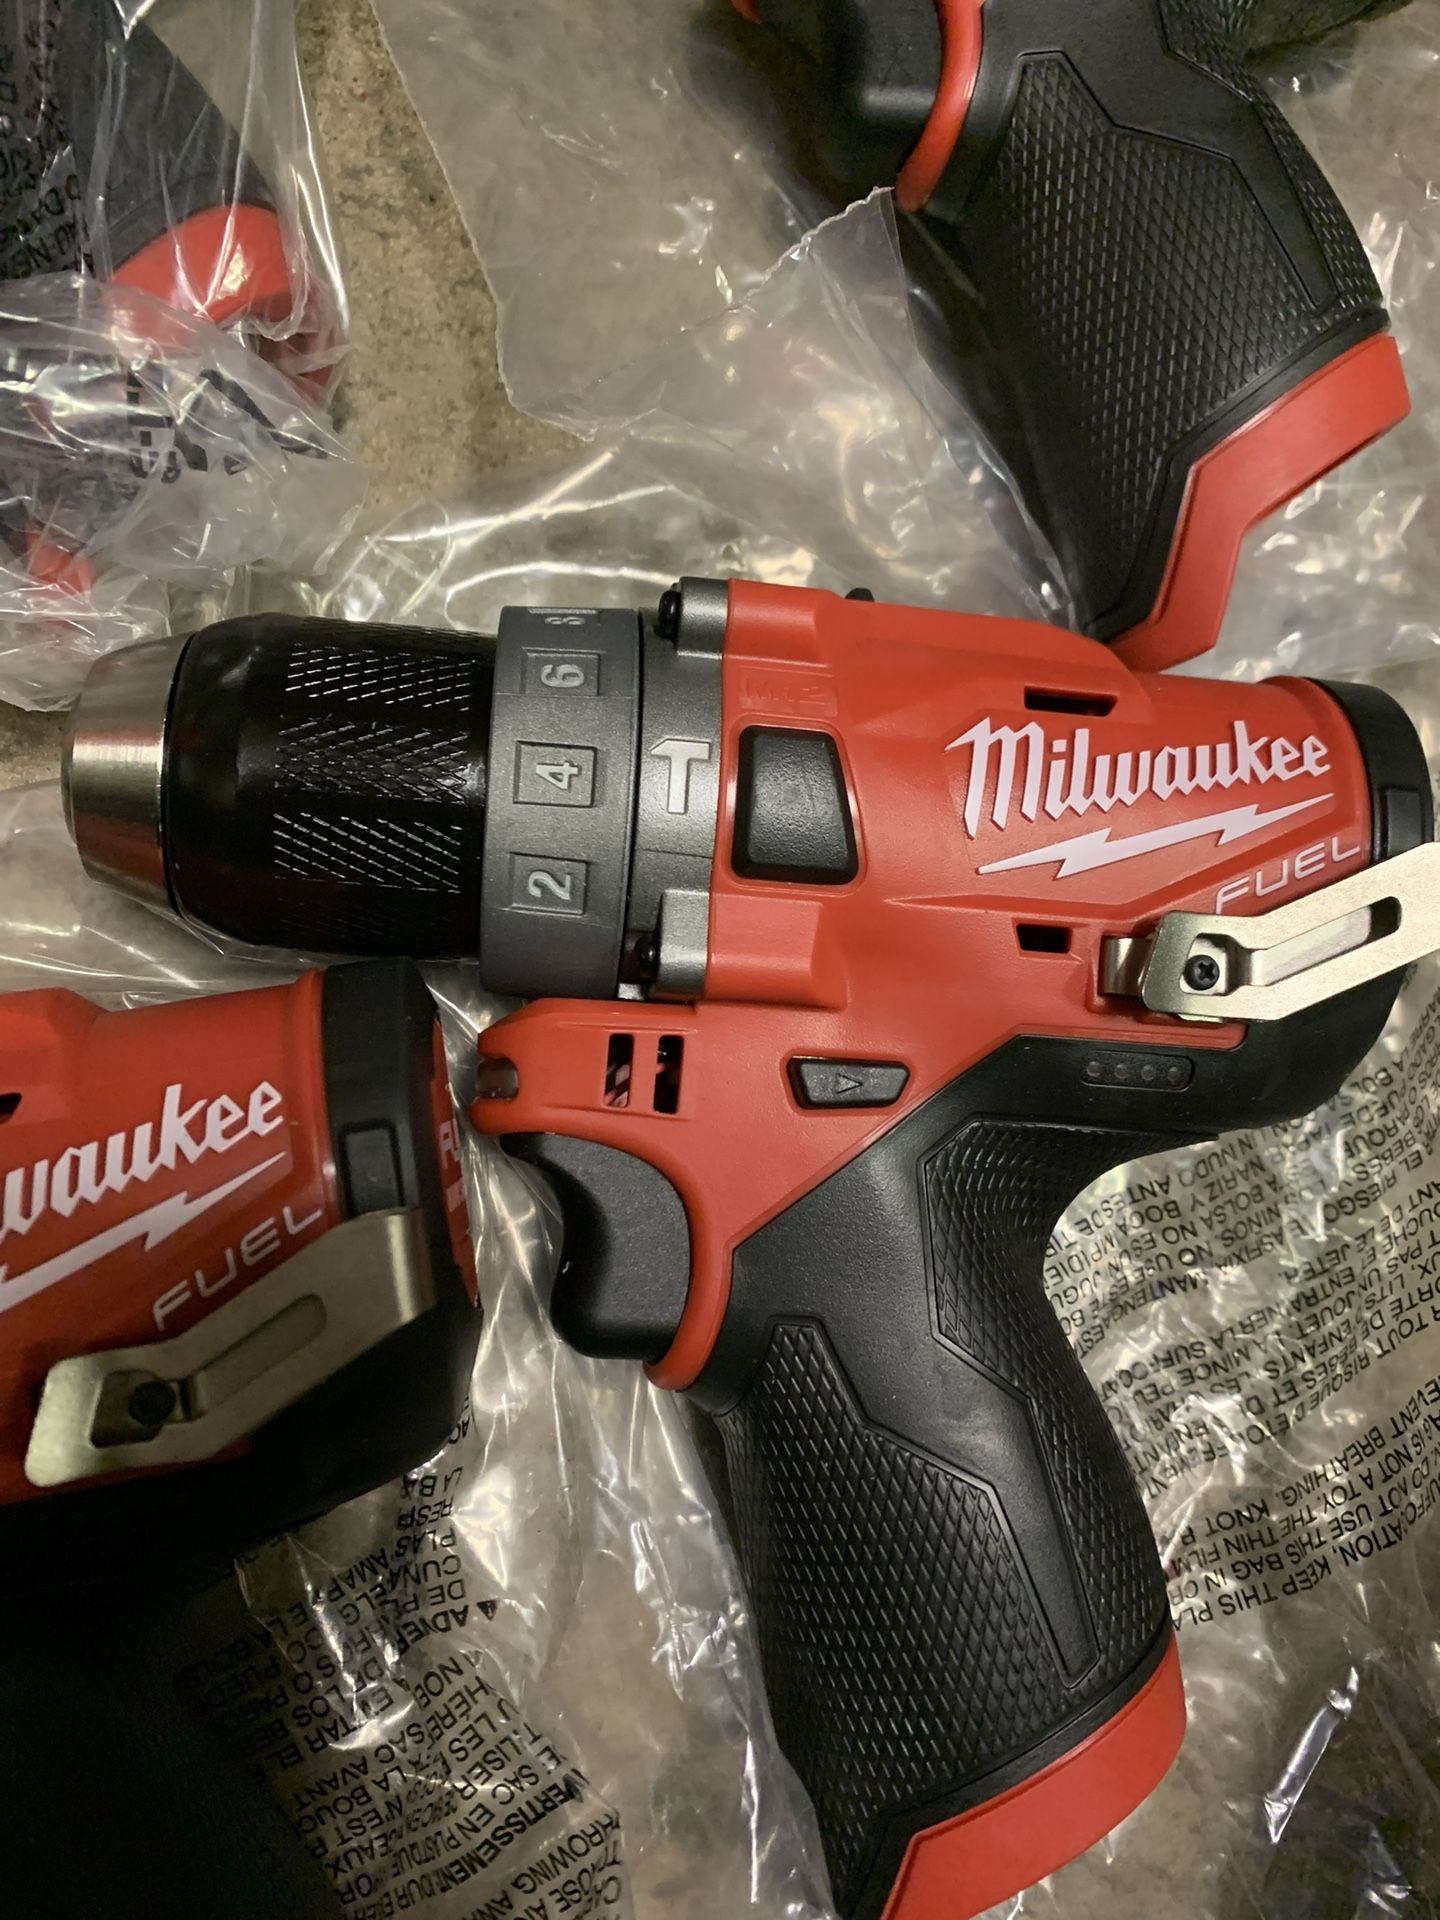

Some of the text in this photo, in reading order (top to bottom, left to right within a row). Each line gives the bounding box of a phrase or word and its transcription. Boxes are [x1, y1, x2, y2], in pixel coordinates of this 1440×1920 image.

[540, 663, 586, 689] 6
[535, 759, 579, 791] 4
[944, 716, 1333, 840] Milwaukee
[528, 869, 572, 901] 2
[1214, 834, 1362, 916] FUEL
[1179, 1144, 1238, 1187] NUDO
[1203, 1155, 1265, 1202] NARIZ
[1398, 1150, 1423, 1171] EL
[1101, 1175, 1169, 1219] ANTES
[1190, 1193, 1205, 1212] Y
[1198, 1184, 1265, 1230] BOLSA
[1324, 1168, 1396, 1225] RIESGO
[1073, 1209, 1105, 1237] DE
[1114, 1199, 1182, 1236] BOCA
[1163, 1220, 1198, 1243] NO
[1379, 1203, 1403, 1233] DE
[151, 1204, 323, 1331] FUEL
[1042, 1230, 1121, 1289] IMPIDIE
[1180, 1240, 1214, 1266] NO
[1385, 1239, 1422, 1273] PAS
[1376, 1312, 1429, 1358] TOUT
[1176, 1345, 1252, 1387] MINCE
[1307, 1349, 1371, 1410] RISQUE
[1272, 1379, 1299, 1407] ET
[1410, 1428, 1425, 1455] IS
[1274, 1426, 1387, 1508] BREATHING.
[1357, 1467, 1372, 1490] A
[1377, 1443, 1414, 1483] NOT
[1316, 1479, 1361, 1513] TOY.
[1206, 1498, 1271, 1535] KNOT
[1277, 1505, 1316, 1537] THE
[1325, 1503, 1374, 1540] USE
[1170, 1542, 1221, 1577] FILM
[1222, 1526, 1279, 1556] THIN
[1284, 1527, 1327, 1564] THIS
[1204, 1567, 1228, 1592] IN
[1230, 1552, 1284, 1580] BAG
[1280, 1553, 1333, 1599] KEEP
[426, 1578, 466, 1606] DE
[1216, 1581, 1279, 1616] THIS
[290, 1684, 345, 1727] LOS
[373, 1722, 429, 1765] SAC
[447, 1712, 498, 1763] LES
[294, 1755, 367, 1812] AVANT
[370, 1764, 408, 1792] LA
[493, 1764, 541, 1808] SAC
[335, 1794, 402, 1846] N'EST
[454, 1802, 496, 1840] EN
